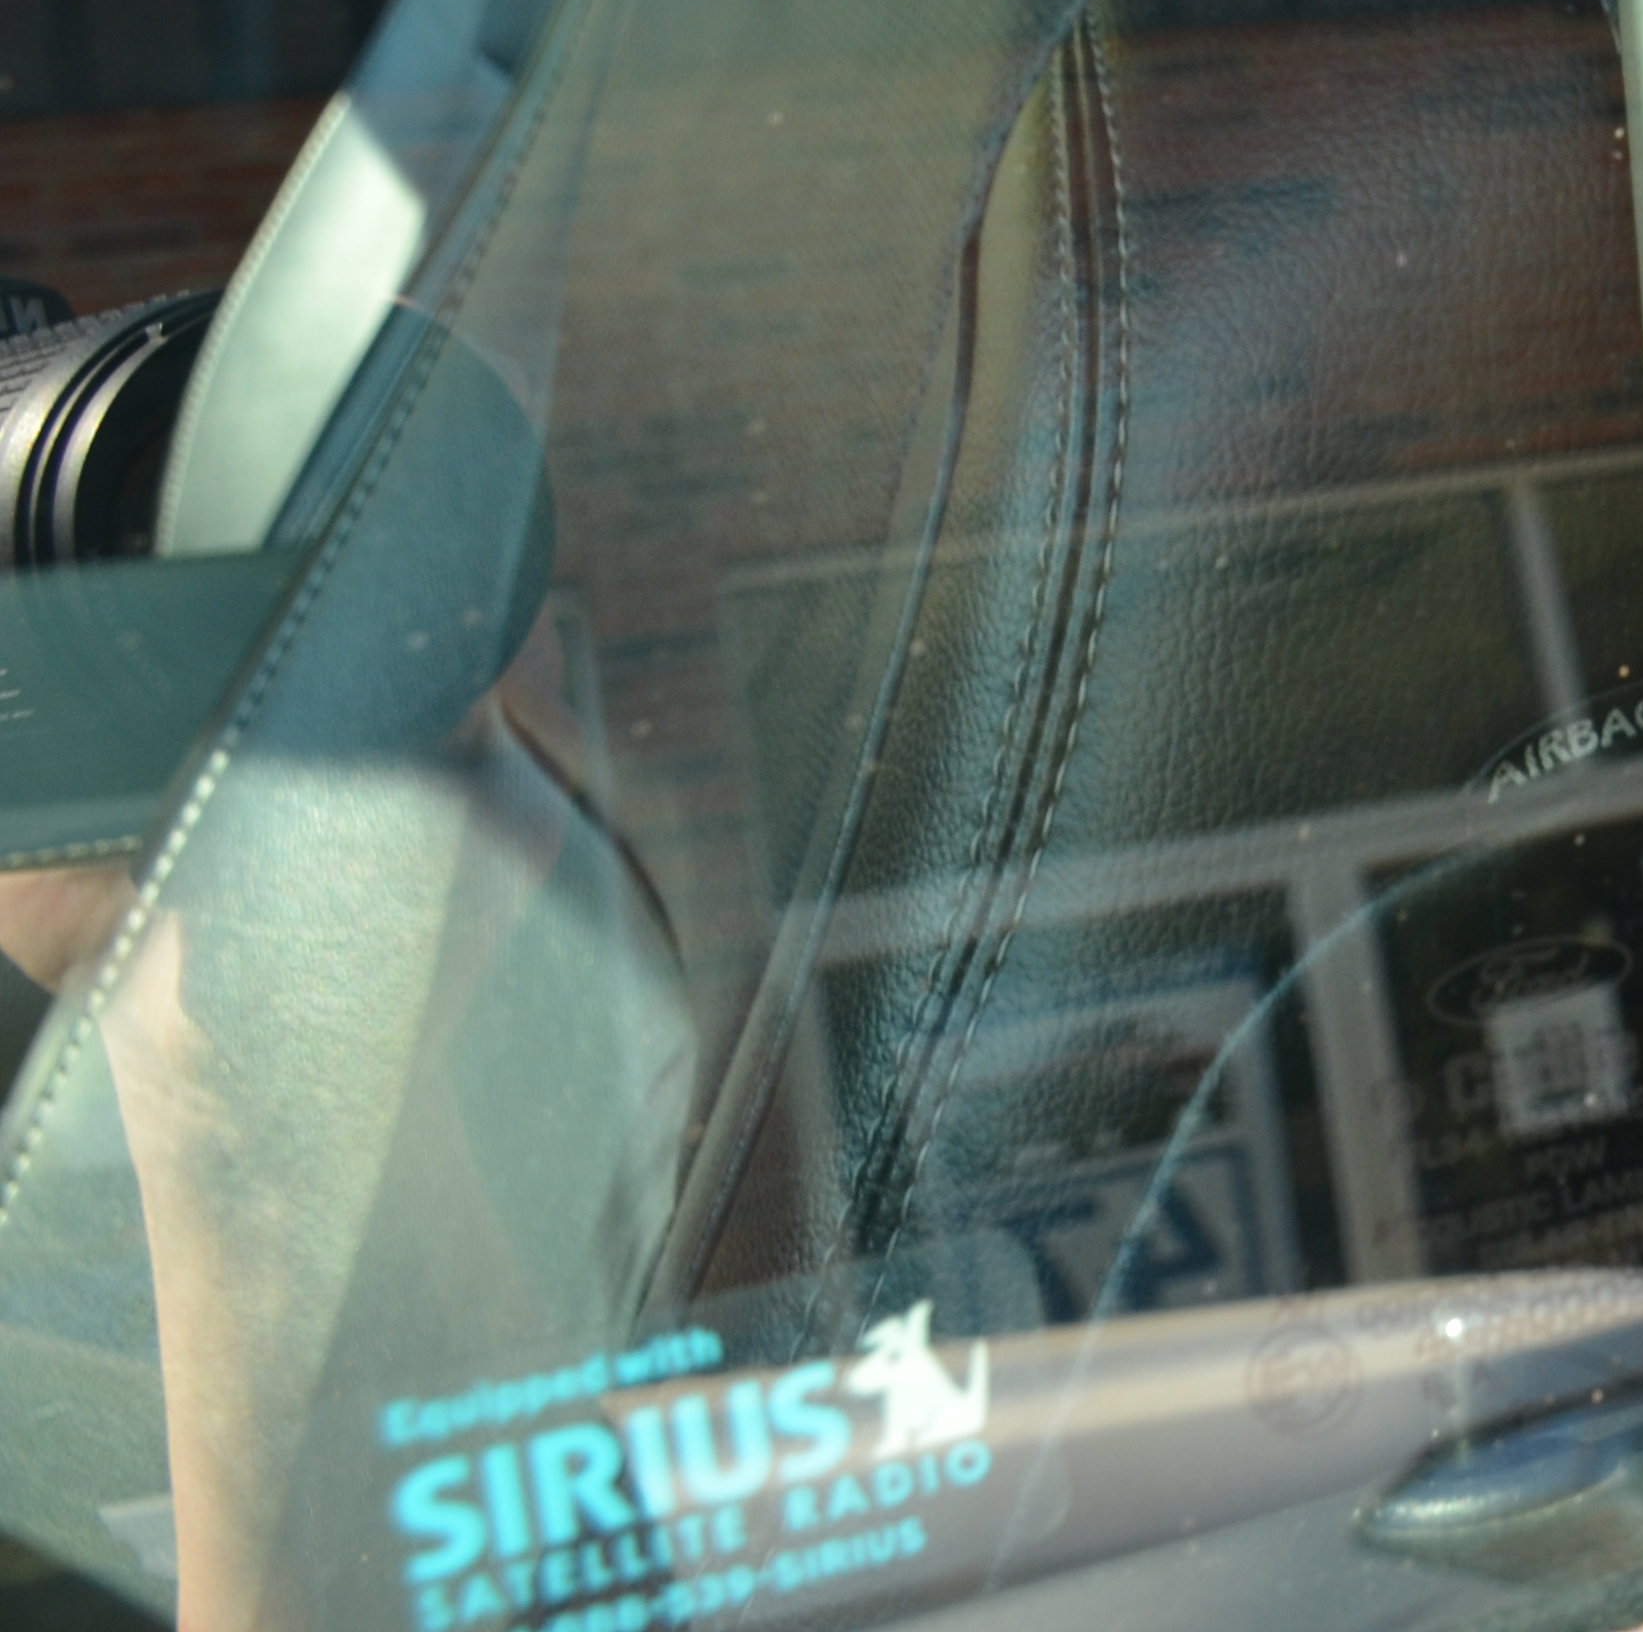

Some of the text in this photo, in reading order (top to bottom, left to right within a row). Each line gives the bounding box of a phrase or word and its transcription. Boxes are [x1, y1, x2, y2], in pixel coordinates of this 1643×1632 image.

[385, 1325, 724, 1444] Equipped with
[390, 1360, 852, 1581] SIRIUS
[414, 1438, 993, 1631] SATELLITE RADIO
